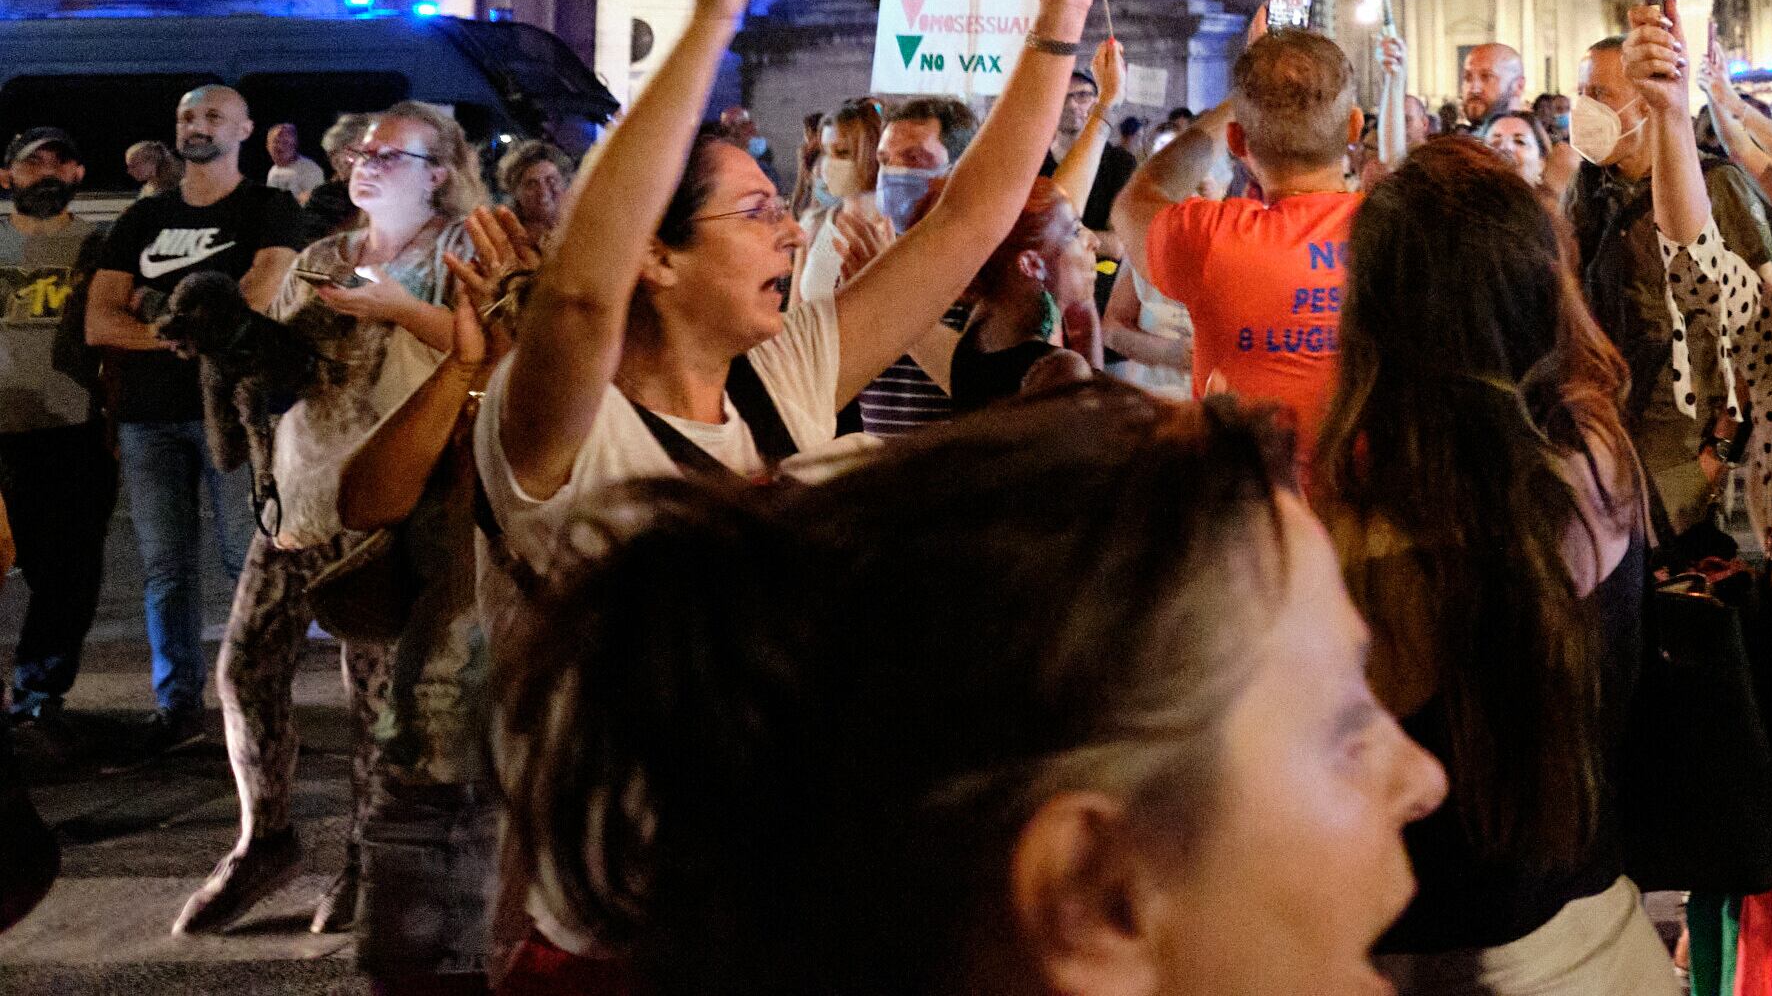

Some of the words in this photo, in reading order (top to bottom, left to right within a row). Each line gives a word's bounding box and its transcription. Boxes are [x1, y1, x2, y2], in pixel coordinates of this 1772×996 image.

[920, 53, 945, 71] NO
[959, 55, 1003, 74] VAX
[148, 228, 220, 256] NIKE
[1238, 327, 1254, 352] 8
